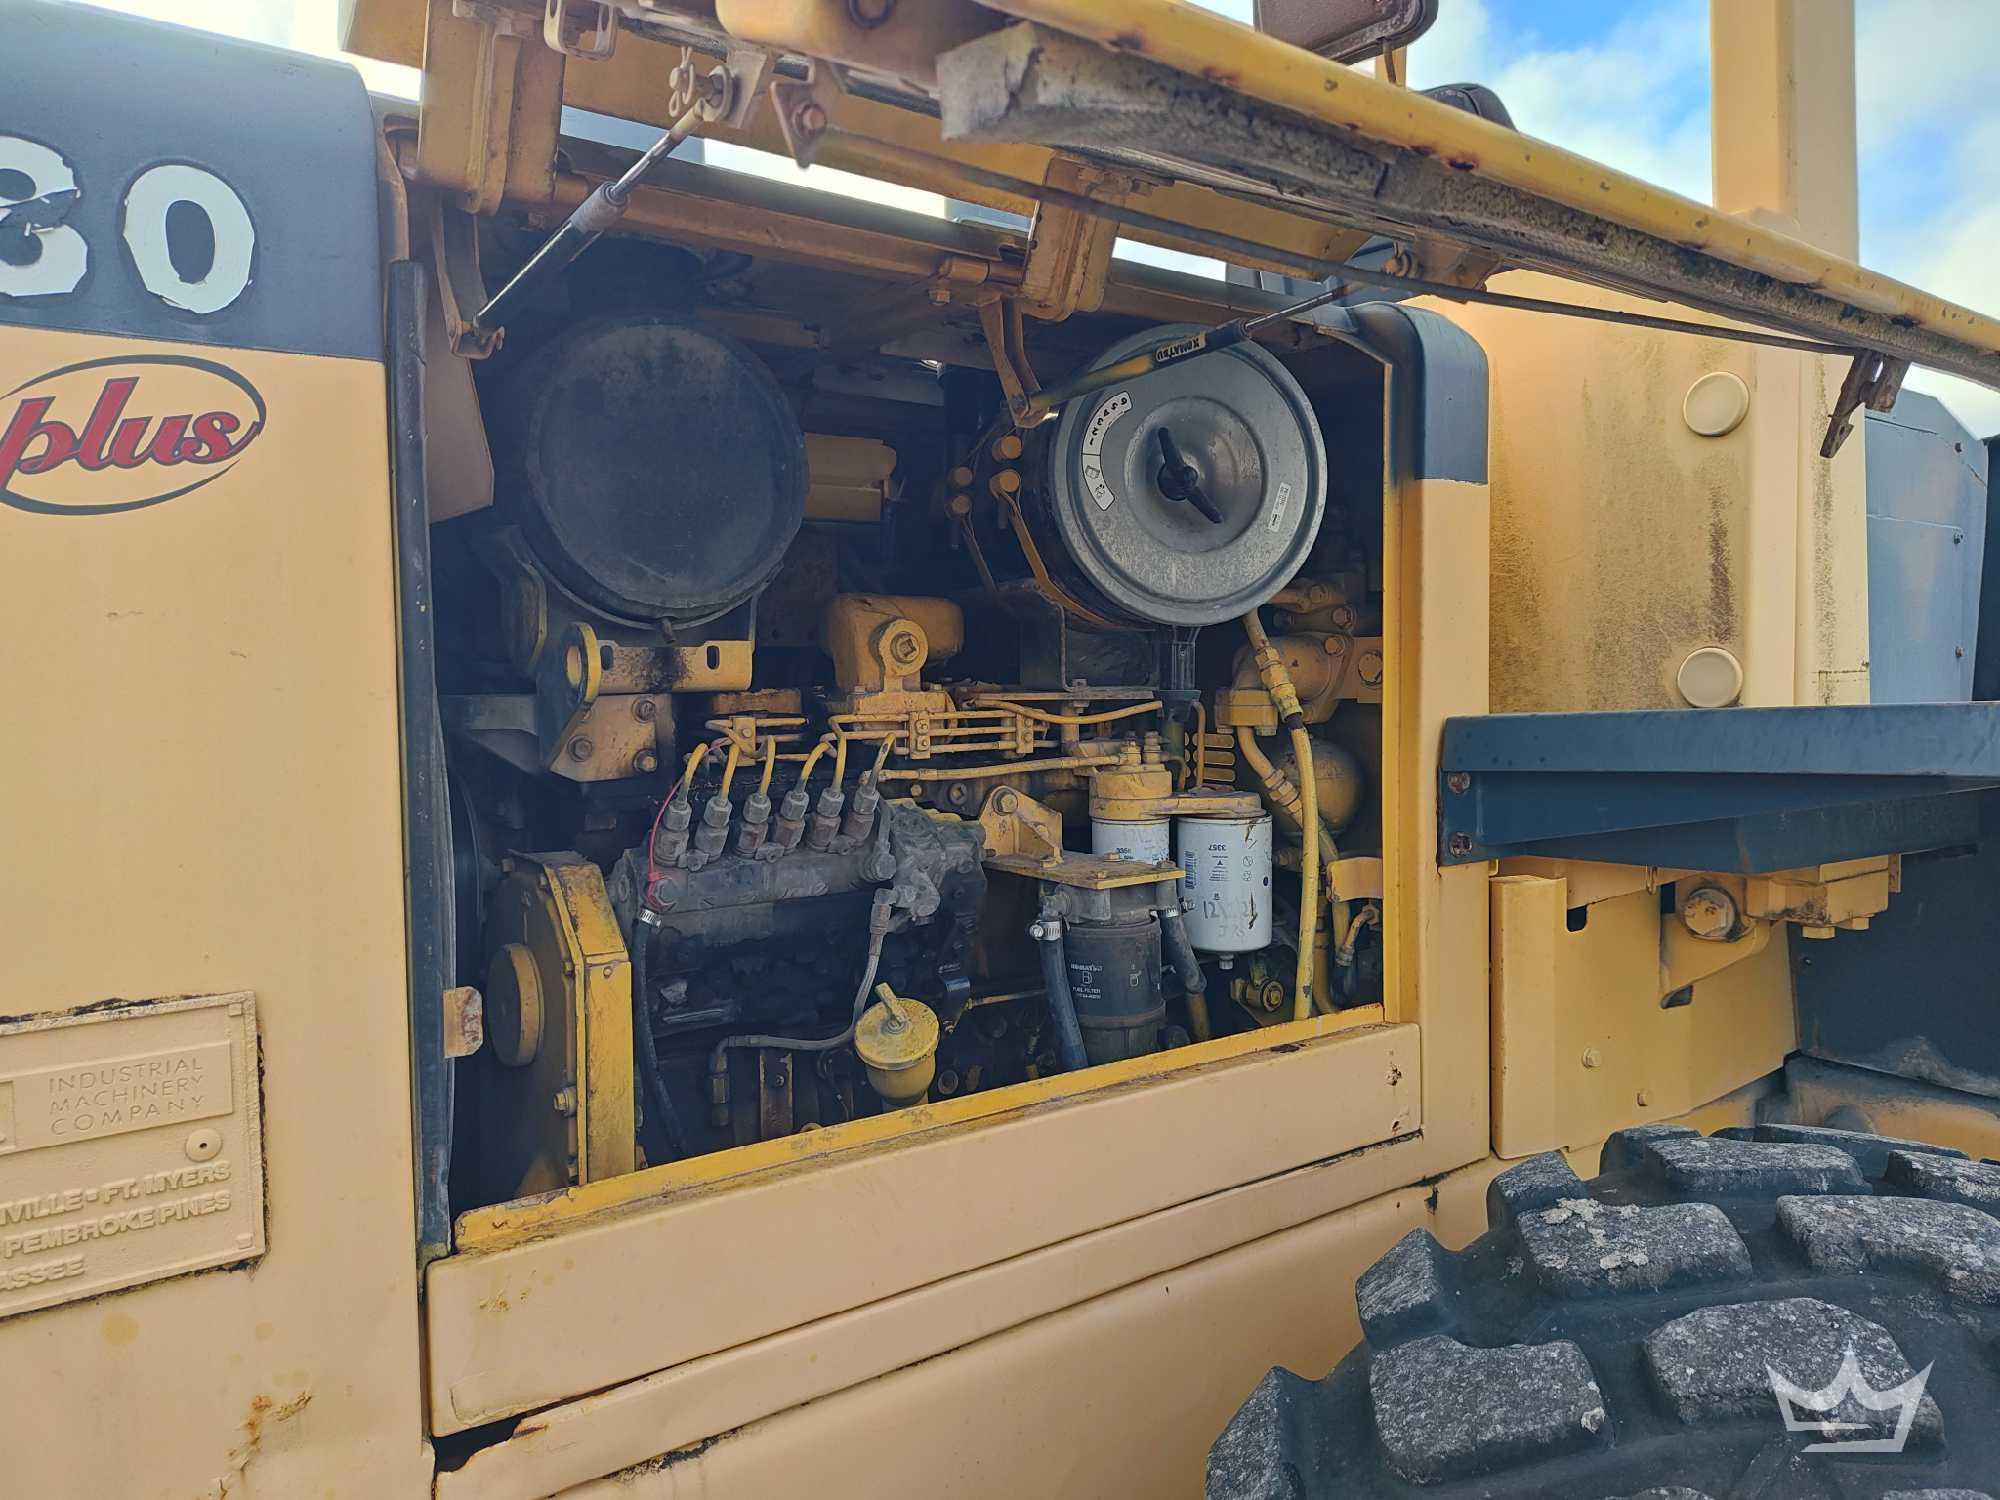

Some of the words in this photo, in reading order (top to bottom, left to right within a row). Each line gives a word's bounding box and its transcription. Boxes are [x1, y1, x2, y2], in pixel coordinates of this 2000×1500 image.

[0, 376, 262, 490] plus
[50, 1057, 203, 1093] INDUSTRIAL
[50, 1075, 203, 1114] MACHINERY
[51, 1095, 204, 1135] COMPANY
[101, 1177, 140, 1204] FT.
[142, 1160, 232, 1195] MYERS
[3, 1206, 156, 1259] PEMBROKE
[158, 1190, 232, 1224] PINES
